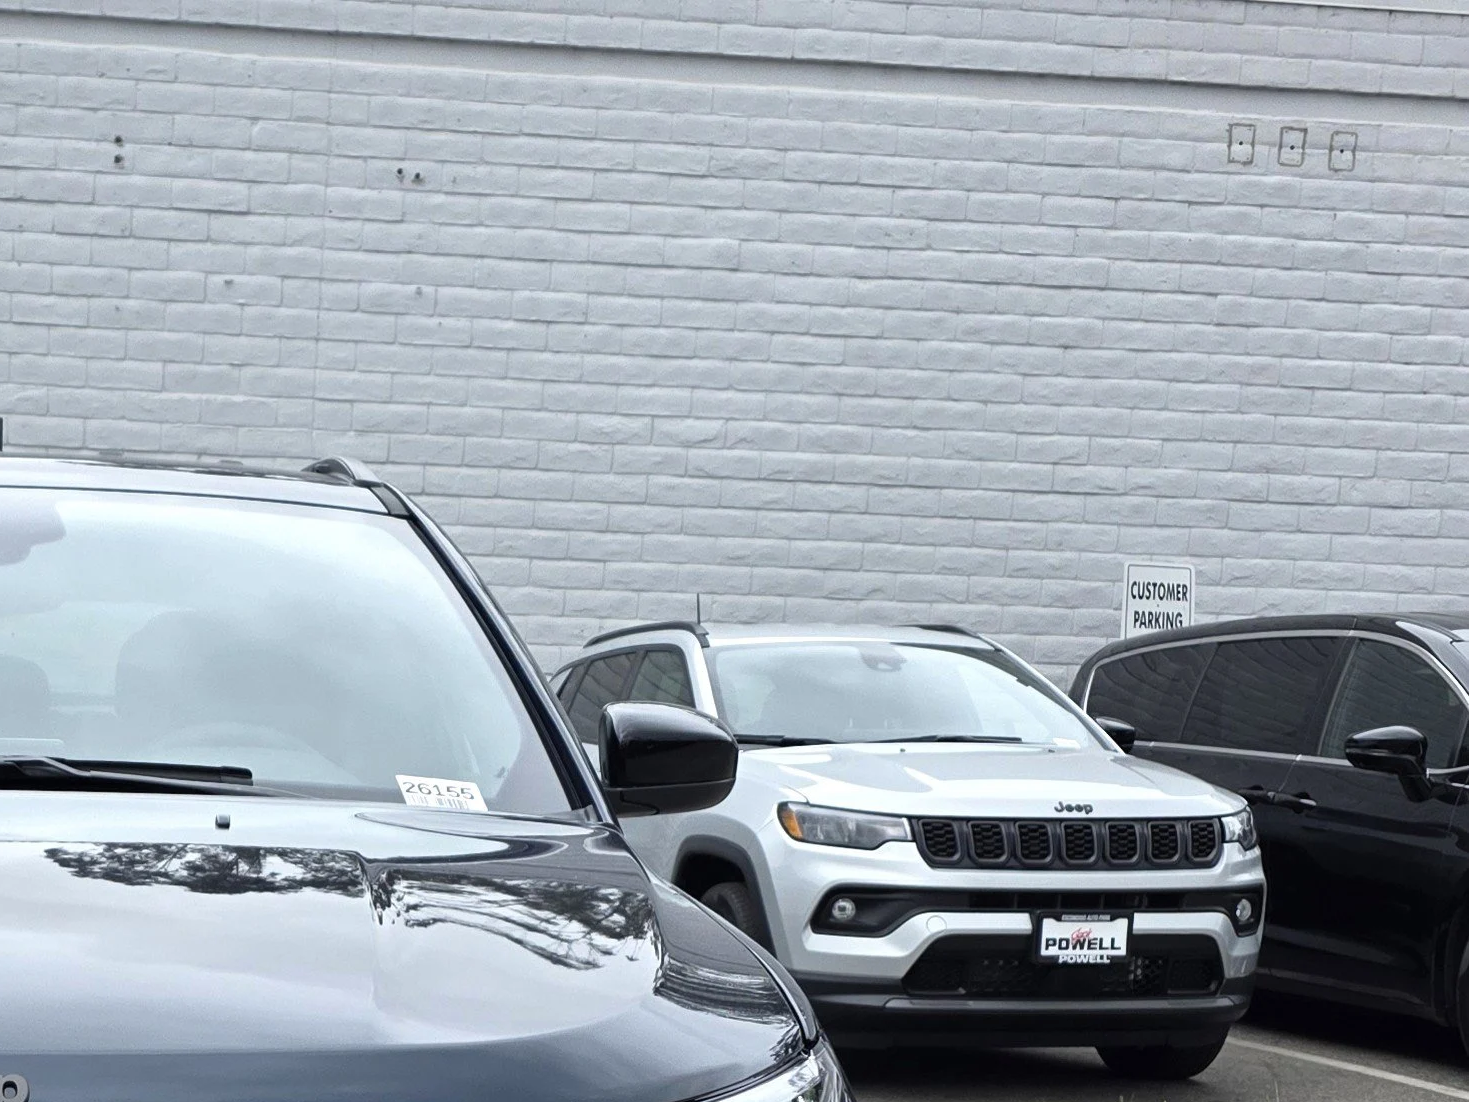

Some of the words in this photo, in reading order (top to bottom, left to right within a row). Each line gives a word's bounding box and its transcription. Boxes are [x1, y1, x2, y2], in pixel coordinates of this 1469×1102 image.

[1131, 581, 1188, 602] CUSTOMER
[1134, 610, 1183, 630] PARKING
[402, 781, 475, 800] 26155
[1054, 801, 1093, 815] Jeep
[1045, 937, 1122, 951] POWELL
[1058, 954, 1111, 964] POWELL
